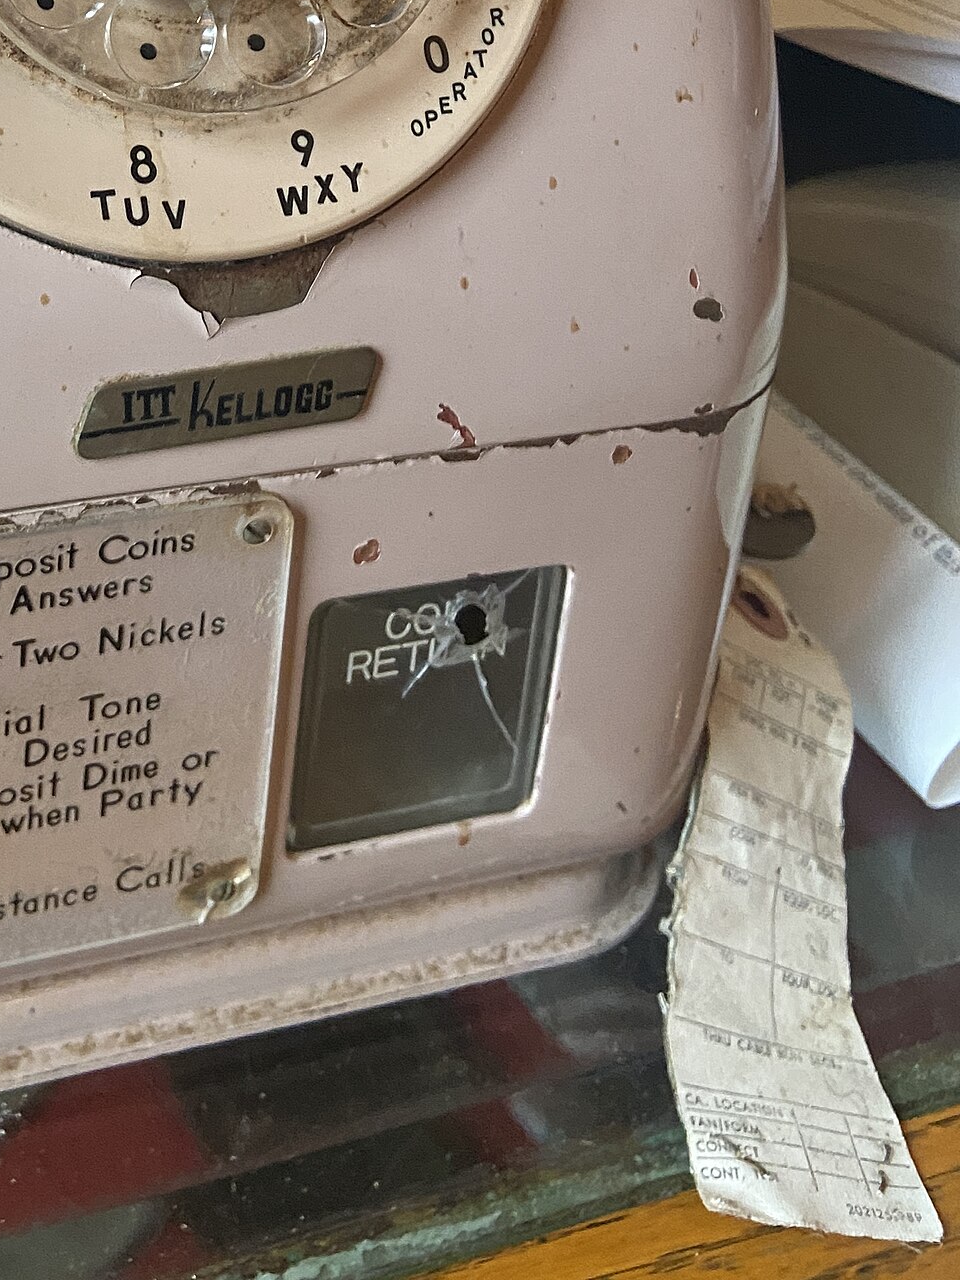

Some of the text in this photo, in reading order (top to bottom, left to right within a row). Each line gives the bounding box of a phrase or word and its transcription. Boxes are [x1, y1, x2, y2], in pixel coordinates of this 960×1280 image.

[410, 7, 505, 137] OPERATOR
[423, 34, 450, 74] 0
[130, 145, 157, 184] 8
[290, 129, 315, 168] 9
[90, 189, 186, 229] TUV
[276, 161, 363, 217] WXY
[121, 376, 334, 432] ITT KELLOGG
[98, 530, 196, 565] Coins
[9, 574, 154, 615] Answers
[12, 638, 80, 668] Two
[98, 611, 226, 656] Nickels
[79, 692, 161, 721] Tone
[24, 719, 152, 768] Desired
[83, 760, 159, 790] Dime
[181, 749, 220, 771] or
[0, 804, 80, 835] when
[100, 779, 204, 817] Party
[116, 854, 206, 892] Calls
